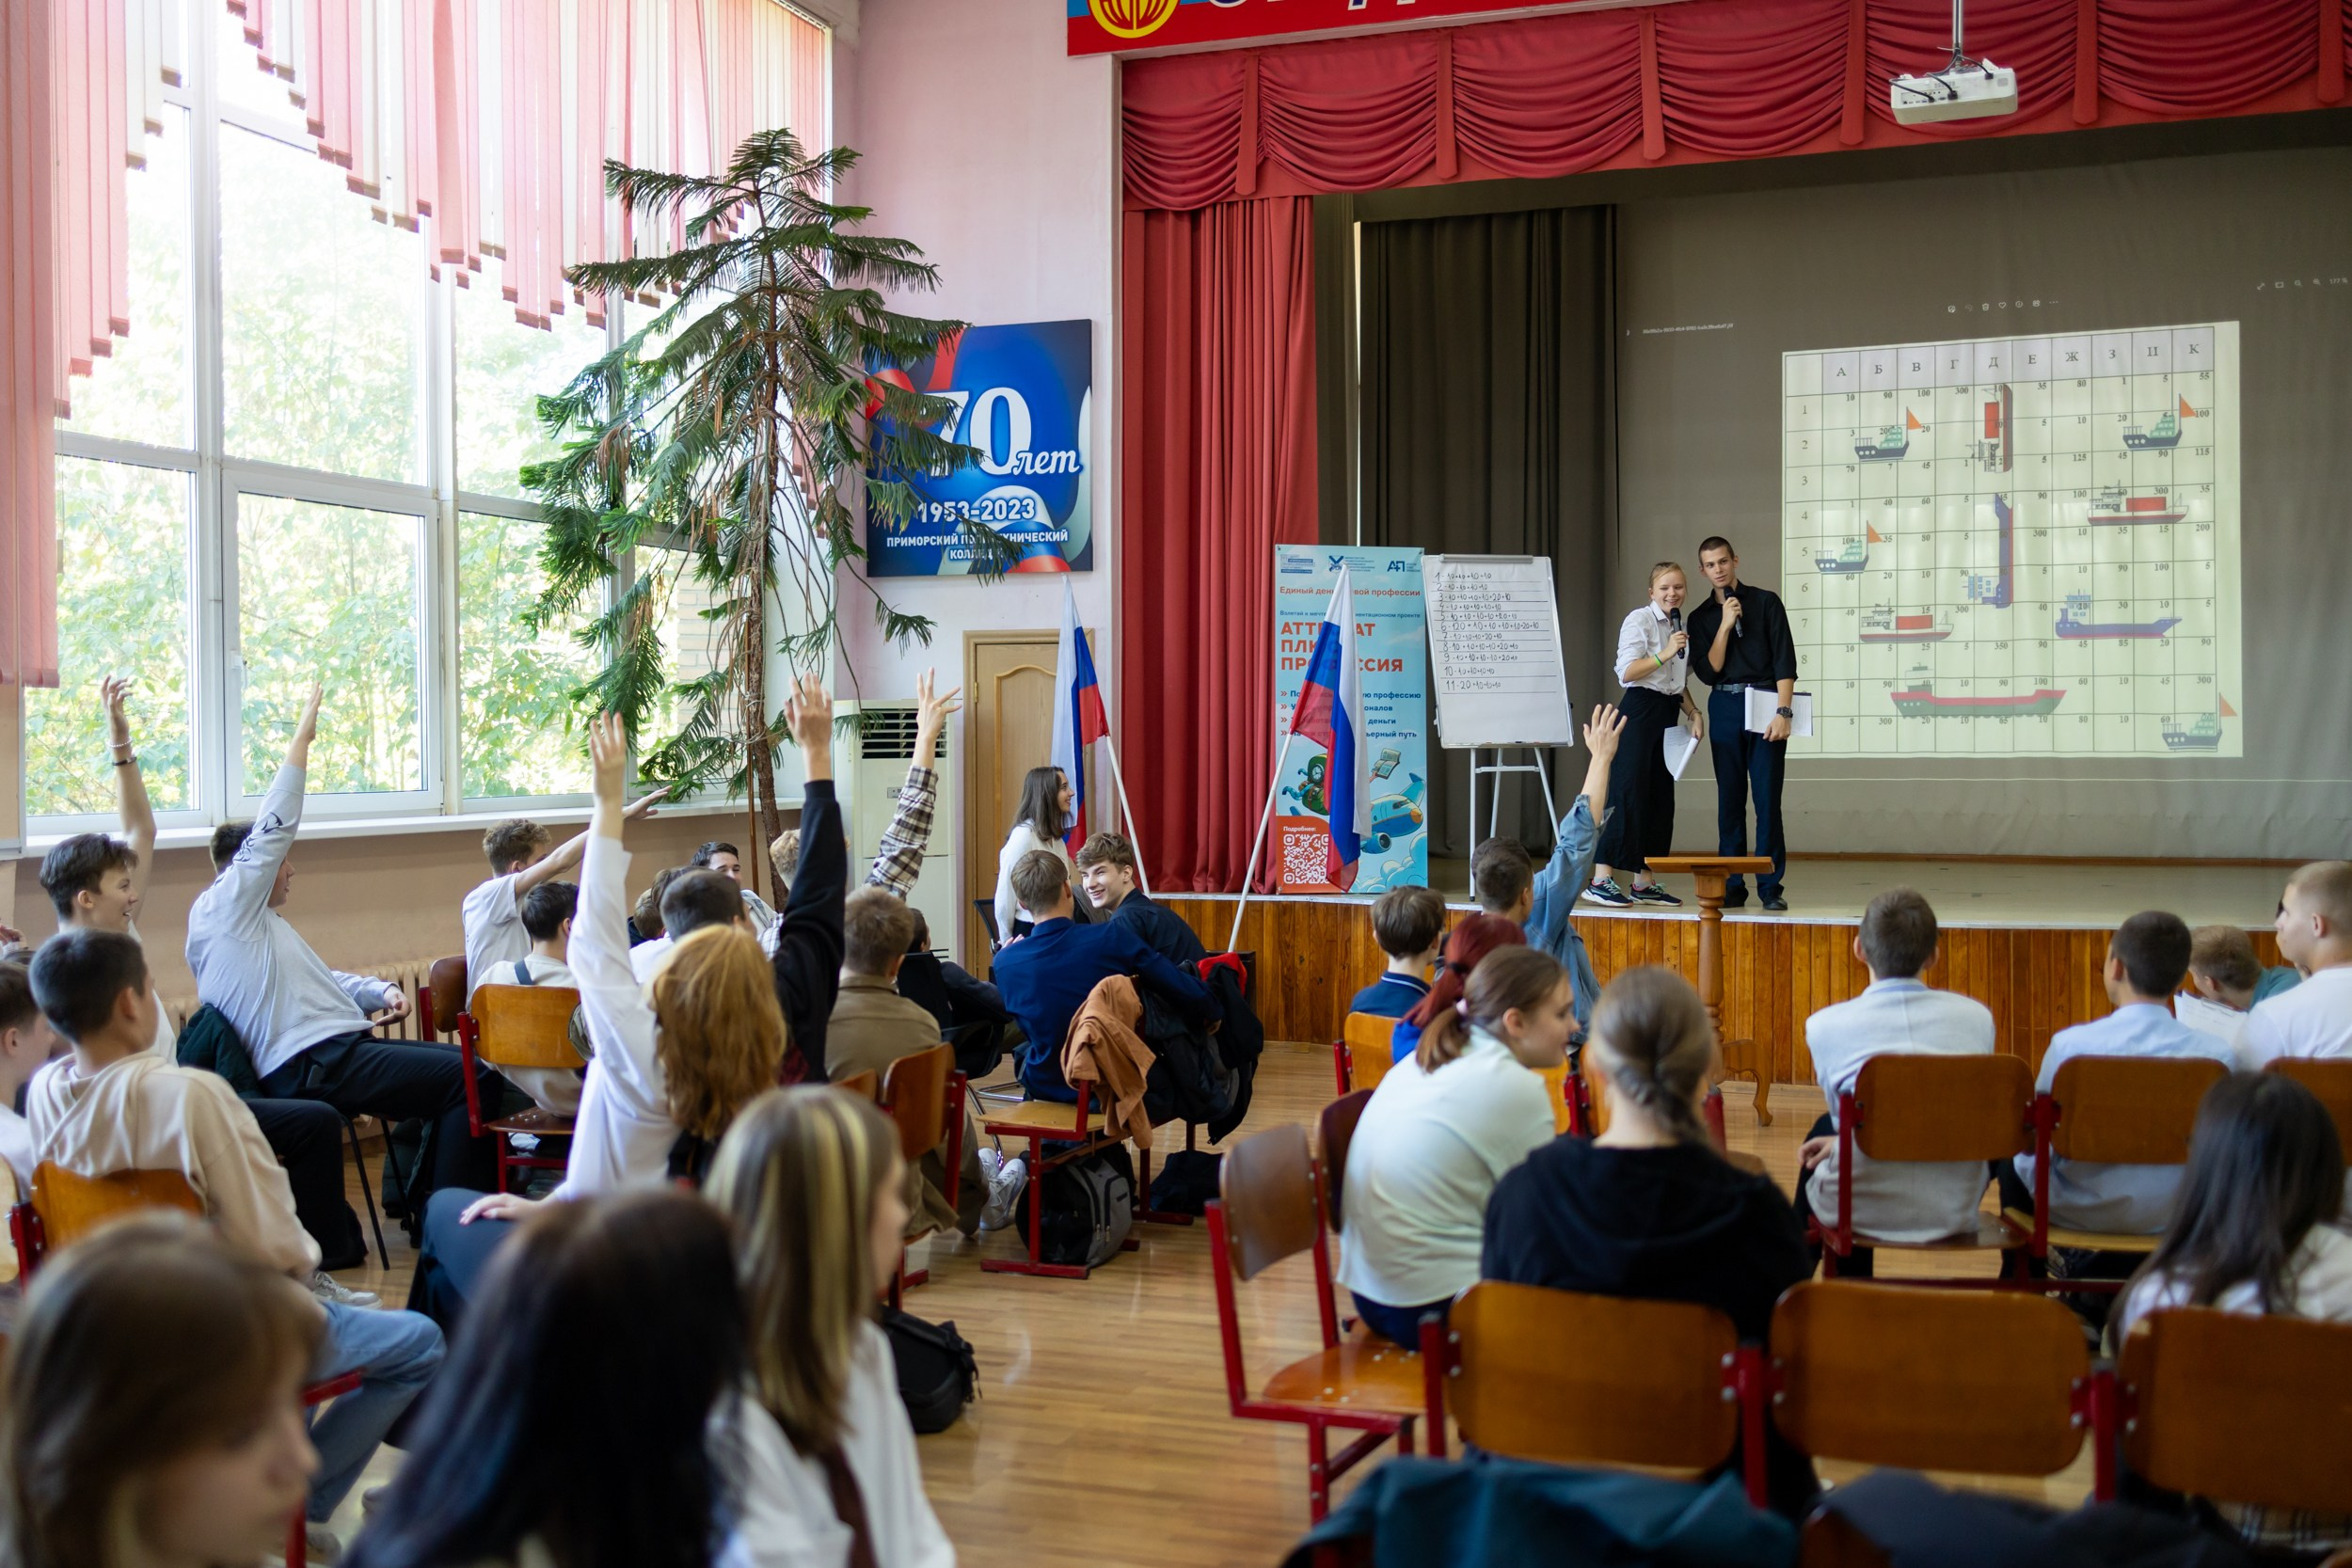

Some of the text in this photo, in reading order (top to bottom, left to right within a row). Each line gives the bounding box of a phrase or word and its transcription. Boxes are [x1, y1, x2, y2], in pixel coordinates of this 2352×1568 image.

[1836, 367, 1847, 376] А
[1874, 364, 1883, 374] Б
[1912, 362, 1921, 372] В
[1950, 359, 1959, 370] Г
[1988, 356, 1999, 369] Д
[2028, 354, 2037, 364] Е
[2065, 351, 2079, 361] Ж
[2108, 349, 2116, 359] З
[2188, 343, 2200, 355] К
[1846, 393, 1855, 402] 10
[1883, 391, 1893, 400] 90
[1955, 387, 1969, 395] 300
[2037, 382, 2047, 390] 35
[2076, 379, 2087, 388] 80
[2163, 374, 2168, 383] 5
[2199, 372, 2210, 380] 55
[1803, 405, 1807, 414] 1
[1850, 429, 1855, 437] 3
[1921, 425, 1931, 434] 20
[2077, 416, 2087, 424] 10
[2118, 414, 2127, 422] 20
[2195, 409, 2210, 418] 100
[1802, 440, 1808, 449] 2
[1012, 450, 1080, 476] лет
[1846, 465, 1855, 473] 70
[1888, 463, 1893, 471] 7
[1964, 459, 1968, 467] 1
[2073, 453, 2087, 462] 125
[2118, 451, 2127, 460] 45
[2158, 450, 2168, 458] 90
[2195, 448, 2210, 456] 115
[1802, 476, 1808, 485] 3
[2038, 492, 2047, 500] 90
[2073, 490, 2087, 499] 100
[2153, 486, 2169, 495] 300
[2200, 484, 2210, 493] 35
[917, 499, 1035, 523] 1953-2023
[1801, 512, 1808, 520] 4
[1921, 533, 1931, 542] 80
[2033, 529, 2047, 537] 300
[2078, 528, 2087, 536] 10
[2118, 526, 2127, 534] 35
[2159, 525, 2169, 533] 15
[2196, 523, 2210, 531] 200
[886, 532, 959, 547] ПРИМОРСКИЙ
[1802, 547, 1808, 556] 5
[2042, 566, 2047, 575] 5
[2078, 565, 2088, 574] 10
[2118, 563, 2128, 572] 90
[2154, 562, 2169, 571] 100
[2205, 562, 2210, 570] 5
[1279, 586, 1313, 594] Единый
[1372, 588, 1421, 597] профессии
[1802, 583, 1808, 593] 6
[1921, 606, 1931, 614] 15
[1955, 605, 1969, 613] 300
[2038, 603, 2047, 611] 40
[2118, 601, 2128, 610] 30
[2159, 600, 2169, 609] 10
[2206, 599, 2211, 608] 5
[1802, 619, 1807, 627] 7
[1846, 644, 1854, 653] 10
[1888, 643, 1893, 652] 5
[1964, 641, 1969, 650] 5
[1994, 641, 2009, 650] 350
[2078, 640, 2088, 648] 45
[2119, 639, 2128, 647] 85
[2160, 639, 2169, 647] 20
[2201, 638, 2211, 646] 90
[1801, 655, 1807, 664] 8
[1846, 680, 1854, 689] 10
[1883, 680, 1893, 689] 90
[1960, 678, 1969, 687] 10
[1999, 678, 2009, 687] 90
[2033, 677, 2048, 686] 100
[2078, 677, 2088, 686] 60
[2119, 676, 2128, 685] 10
[2160, 676, 2170, 685] 45
[2197, 675, 2212, 684] 300
[1373, 690, 1422, 700] профессию
[1850, 717, 1854, 725] 8
[1879, 717, 1893, 725] 300
[1921, 716, 1931, 724] 20
[1960, 716, 1969, 724] 10
[1999, 716, 2009, 724] 65
[2039, 715, 2048, 723] 10
[2078, 715, 2088, 723] 80
[2120, 715, 2129, 723] 10
